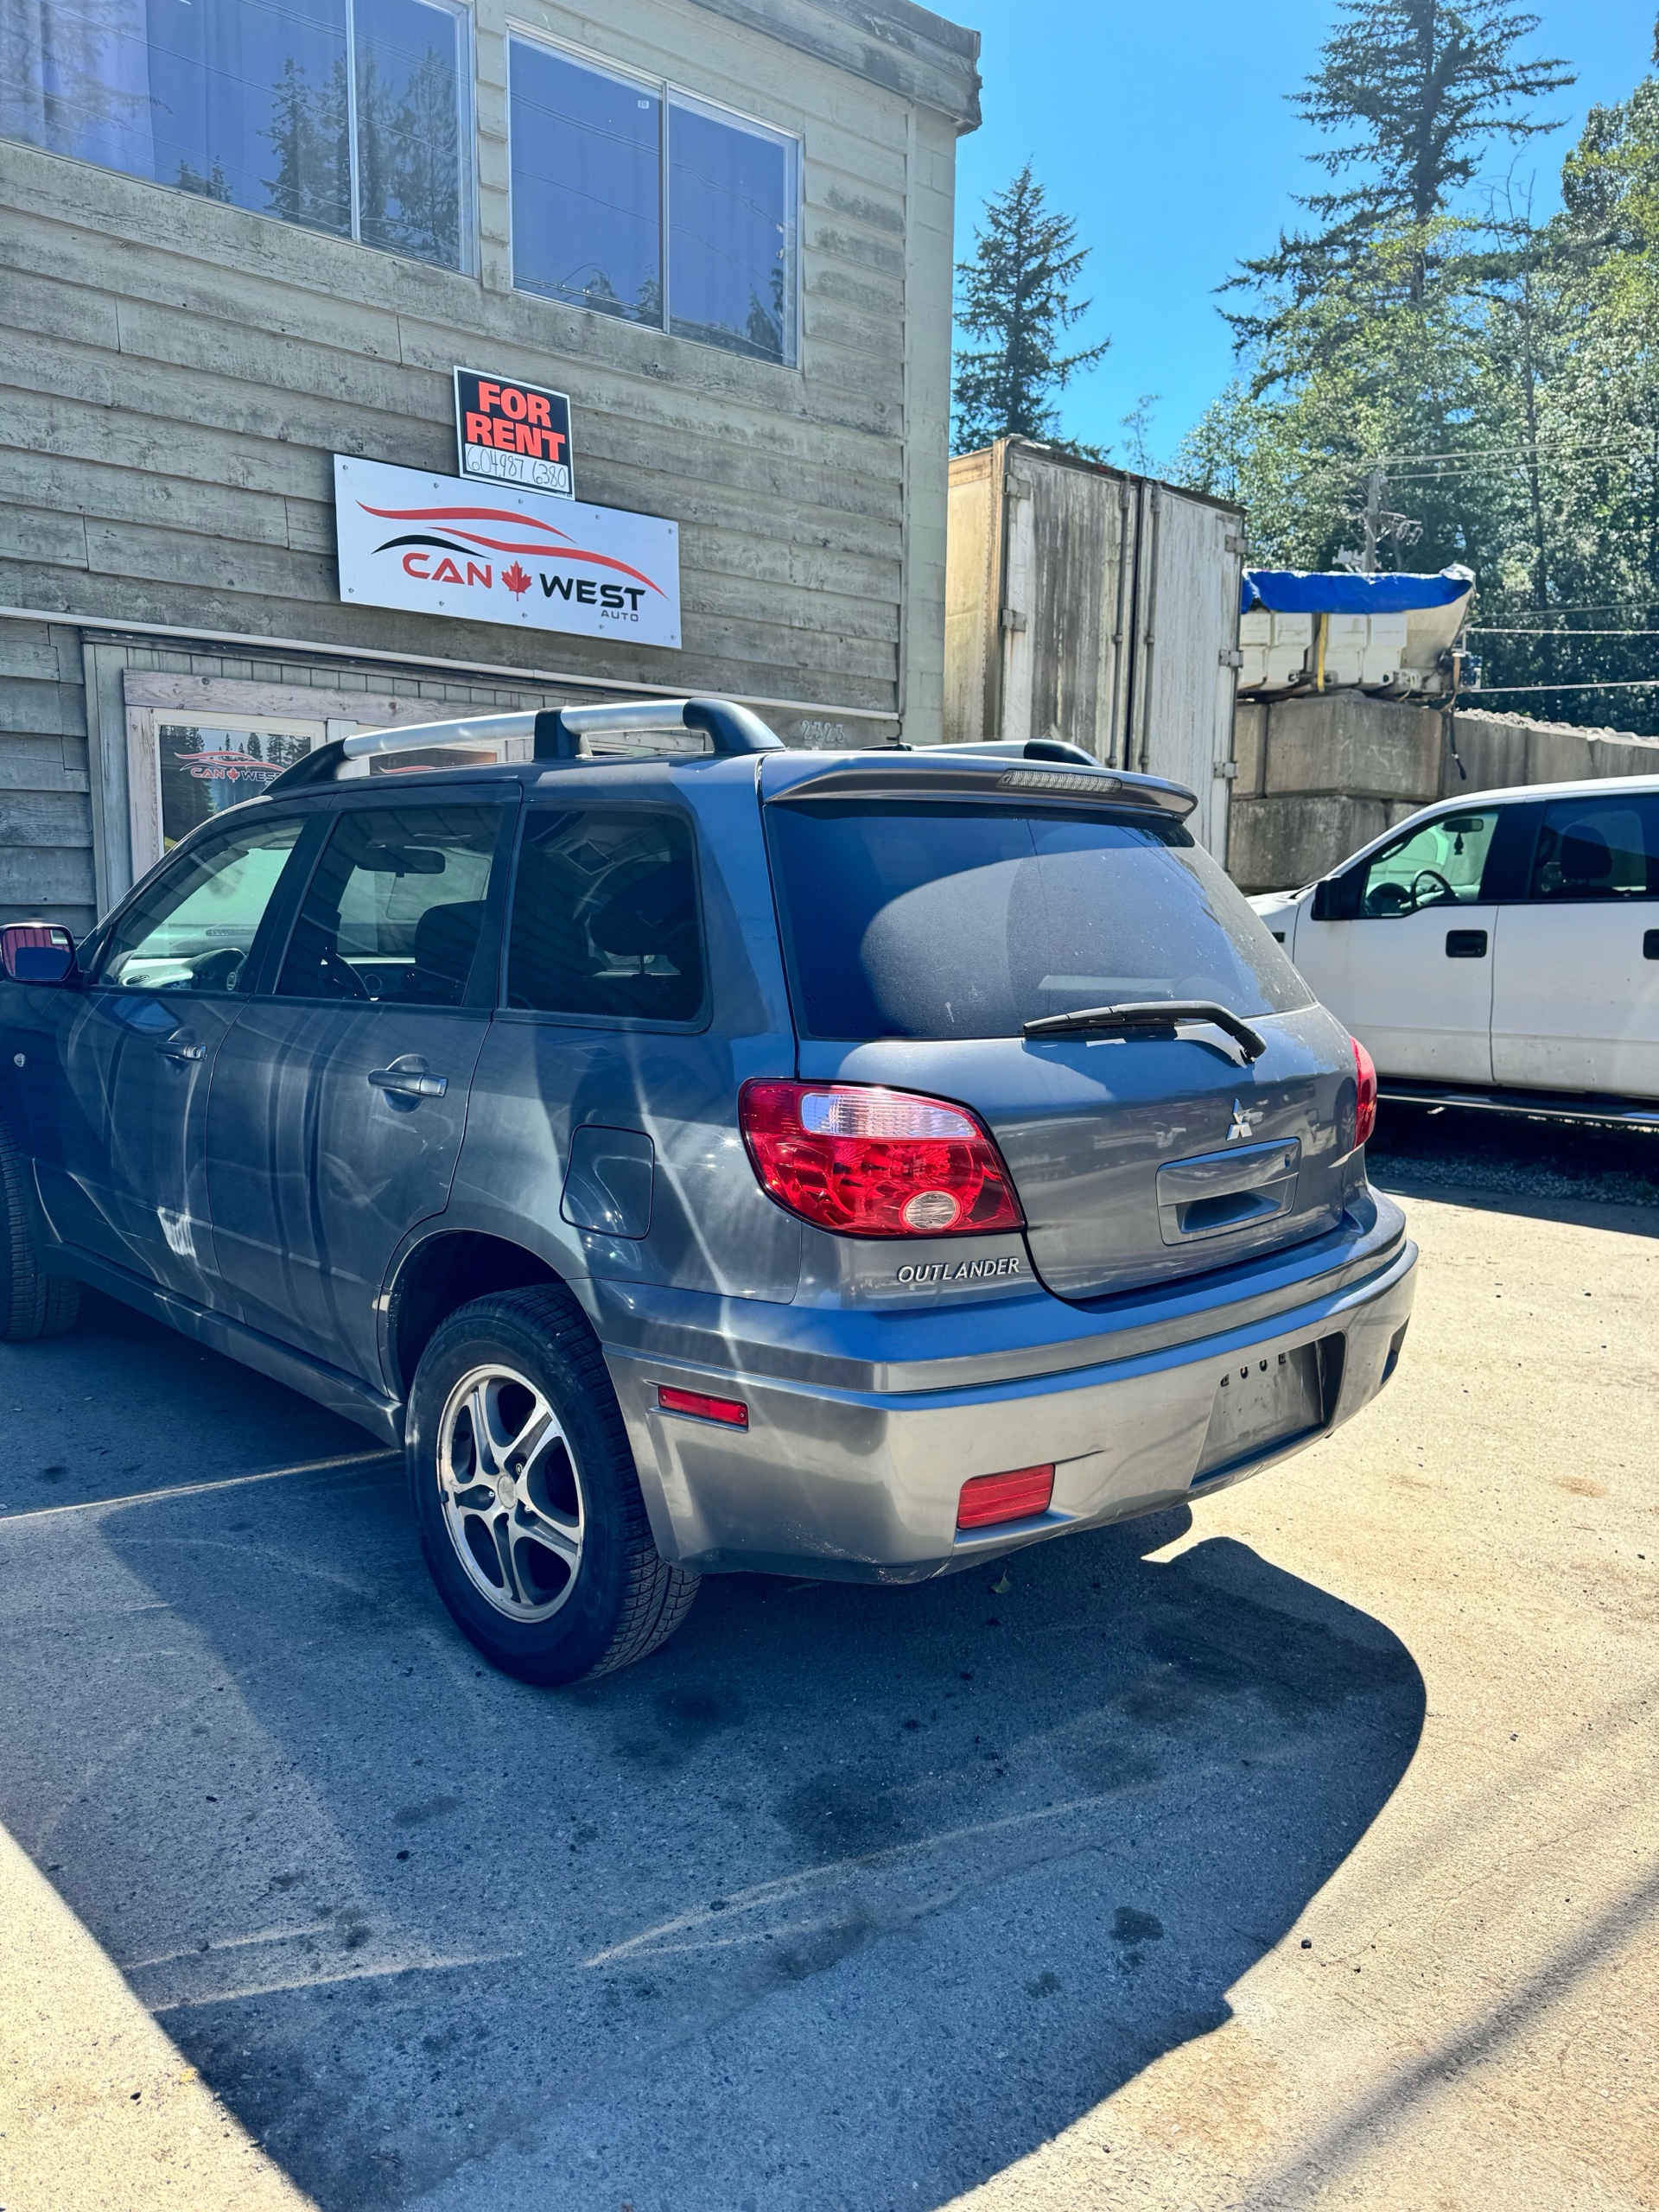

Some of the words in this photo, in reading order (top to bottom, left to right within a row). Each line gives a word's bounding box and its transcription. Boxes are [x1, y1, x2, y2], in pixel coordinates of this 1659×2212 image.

[478, 380, 552, 429] FOR
[466, 411, 566, 462] RENT
[402, 552, 493, 589] CAN
[539, 573, 646, 611] WEST
[601, 609, 639, 622] AUTO
[801, 720, 845, 743] 2323
[190, 766, 226, 779] CAN
[897, 1257, 1020, 1284] OUTLANDER
